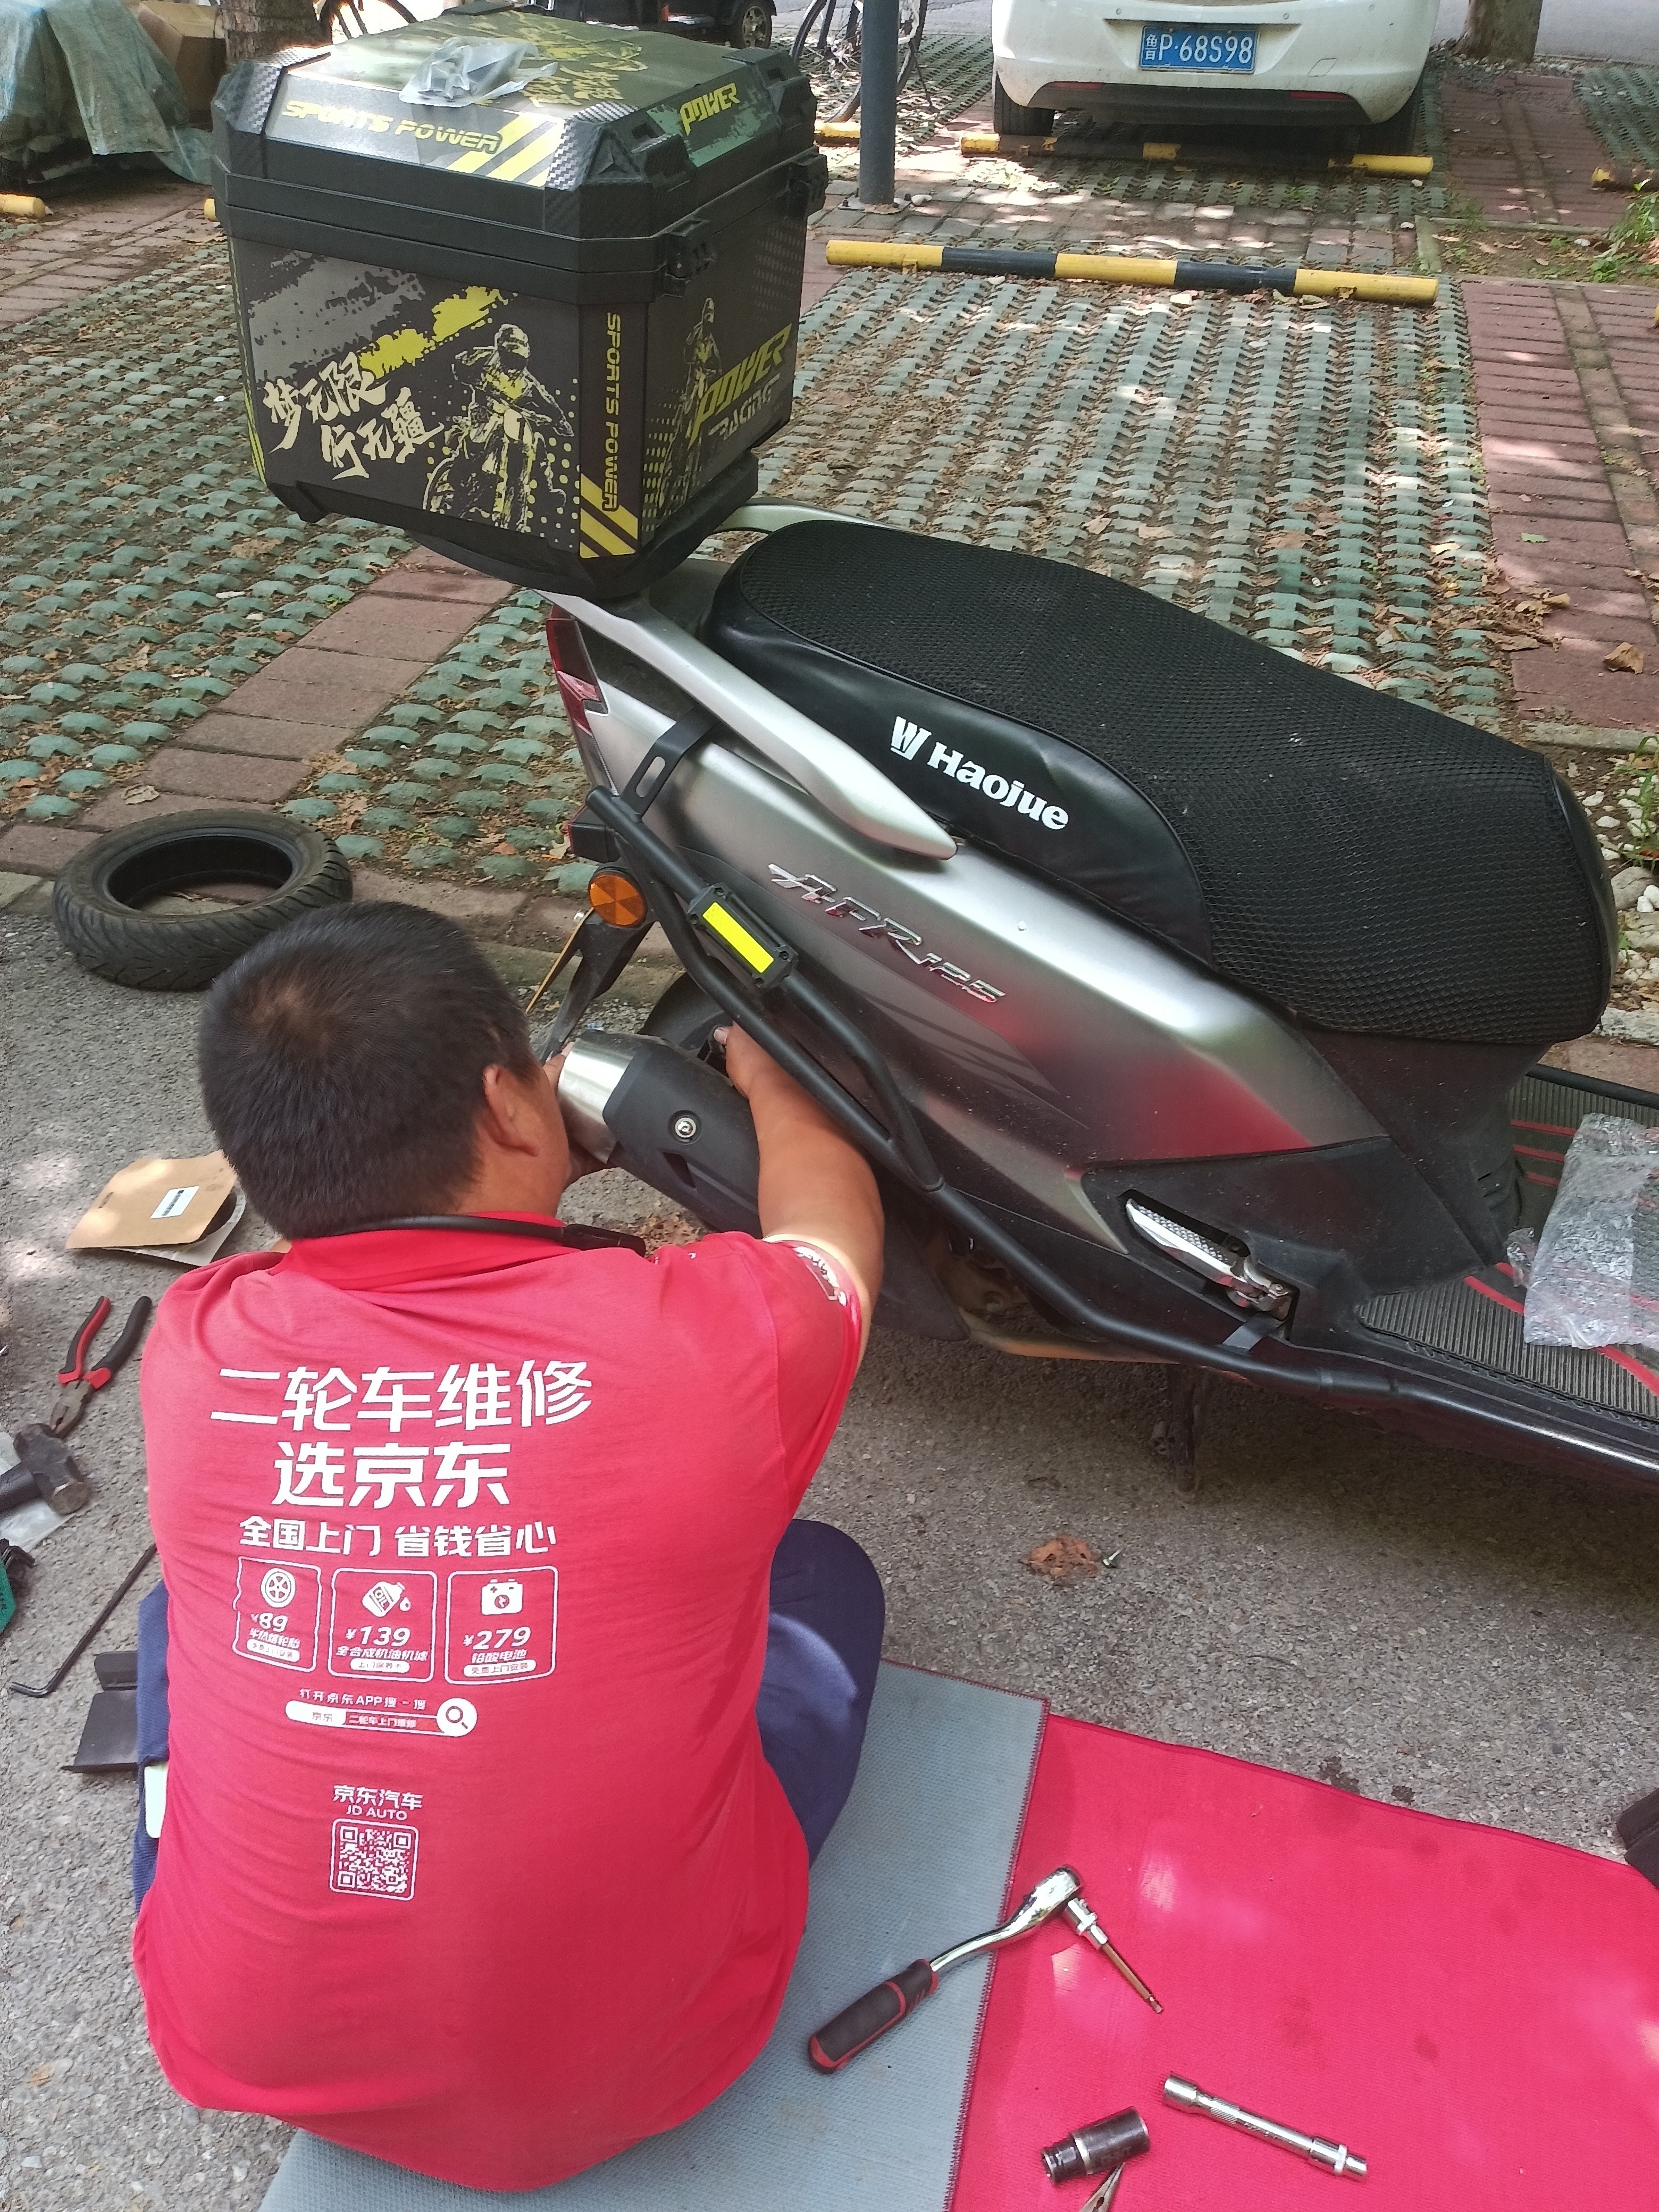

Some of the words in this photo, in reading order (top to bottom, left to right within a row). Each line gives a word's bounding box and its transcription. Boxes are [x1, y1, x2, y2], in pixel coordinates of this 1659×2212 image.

[281, 100, 393, 133] SPORTS
[395, 119, 501, 153] POWER
[680, 82, 741, 136] POWER
[606, 312, 621, 415] SPORTS
[686, 322, 793, 451] POWER
[604, 421, 619, 510] POWER
[926, 741, 1069, 830] Haojue
[210, 1359, 592, 1432] 二轮车维修
[271, 1440, 512, 1509] 选京东
[238, 1515, 381, 1556] 全国上门
[393, 1520, 557, 1558] 省钱省心
[471, 1648, 527, 1663] 铅酸电池
[332, 1784, 424, 1811] 京东汽车
[346, 1805, 363, 1815] JD
[365, 1807, 408, 1821] AUTO
